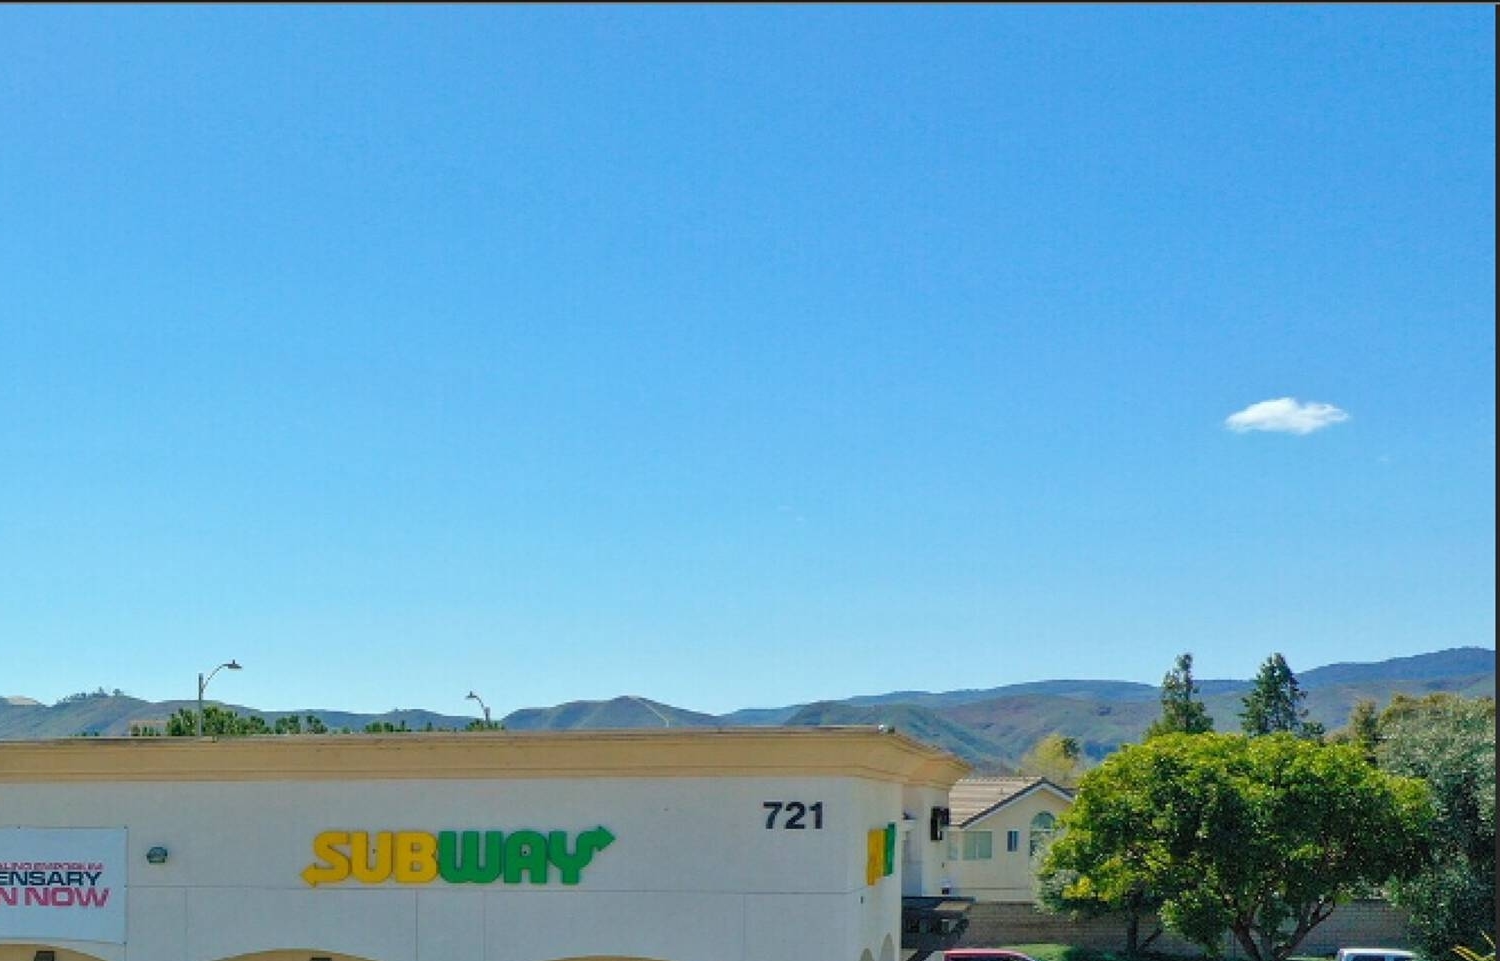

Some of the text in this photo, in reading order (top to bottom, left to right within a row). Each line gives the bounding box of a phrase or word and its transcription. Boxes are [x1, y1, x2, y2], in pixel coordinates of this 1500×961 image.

[763, 802, 823, 829] 721
[301, 826, 615, 887] SUBWAY
[24, 887, 110, 907] NOW
